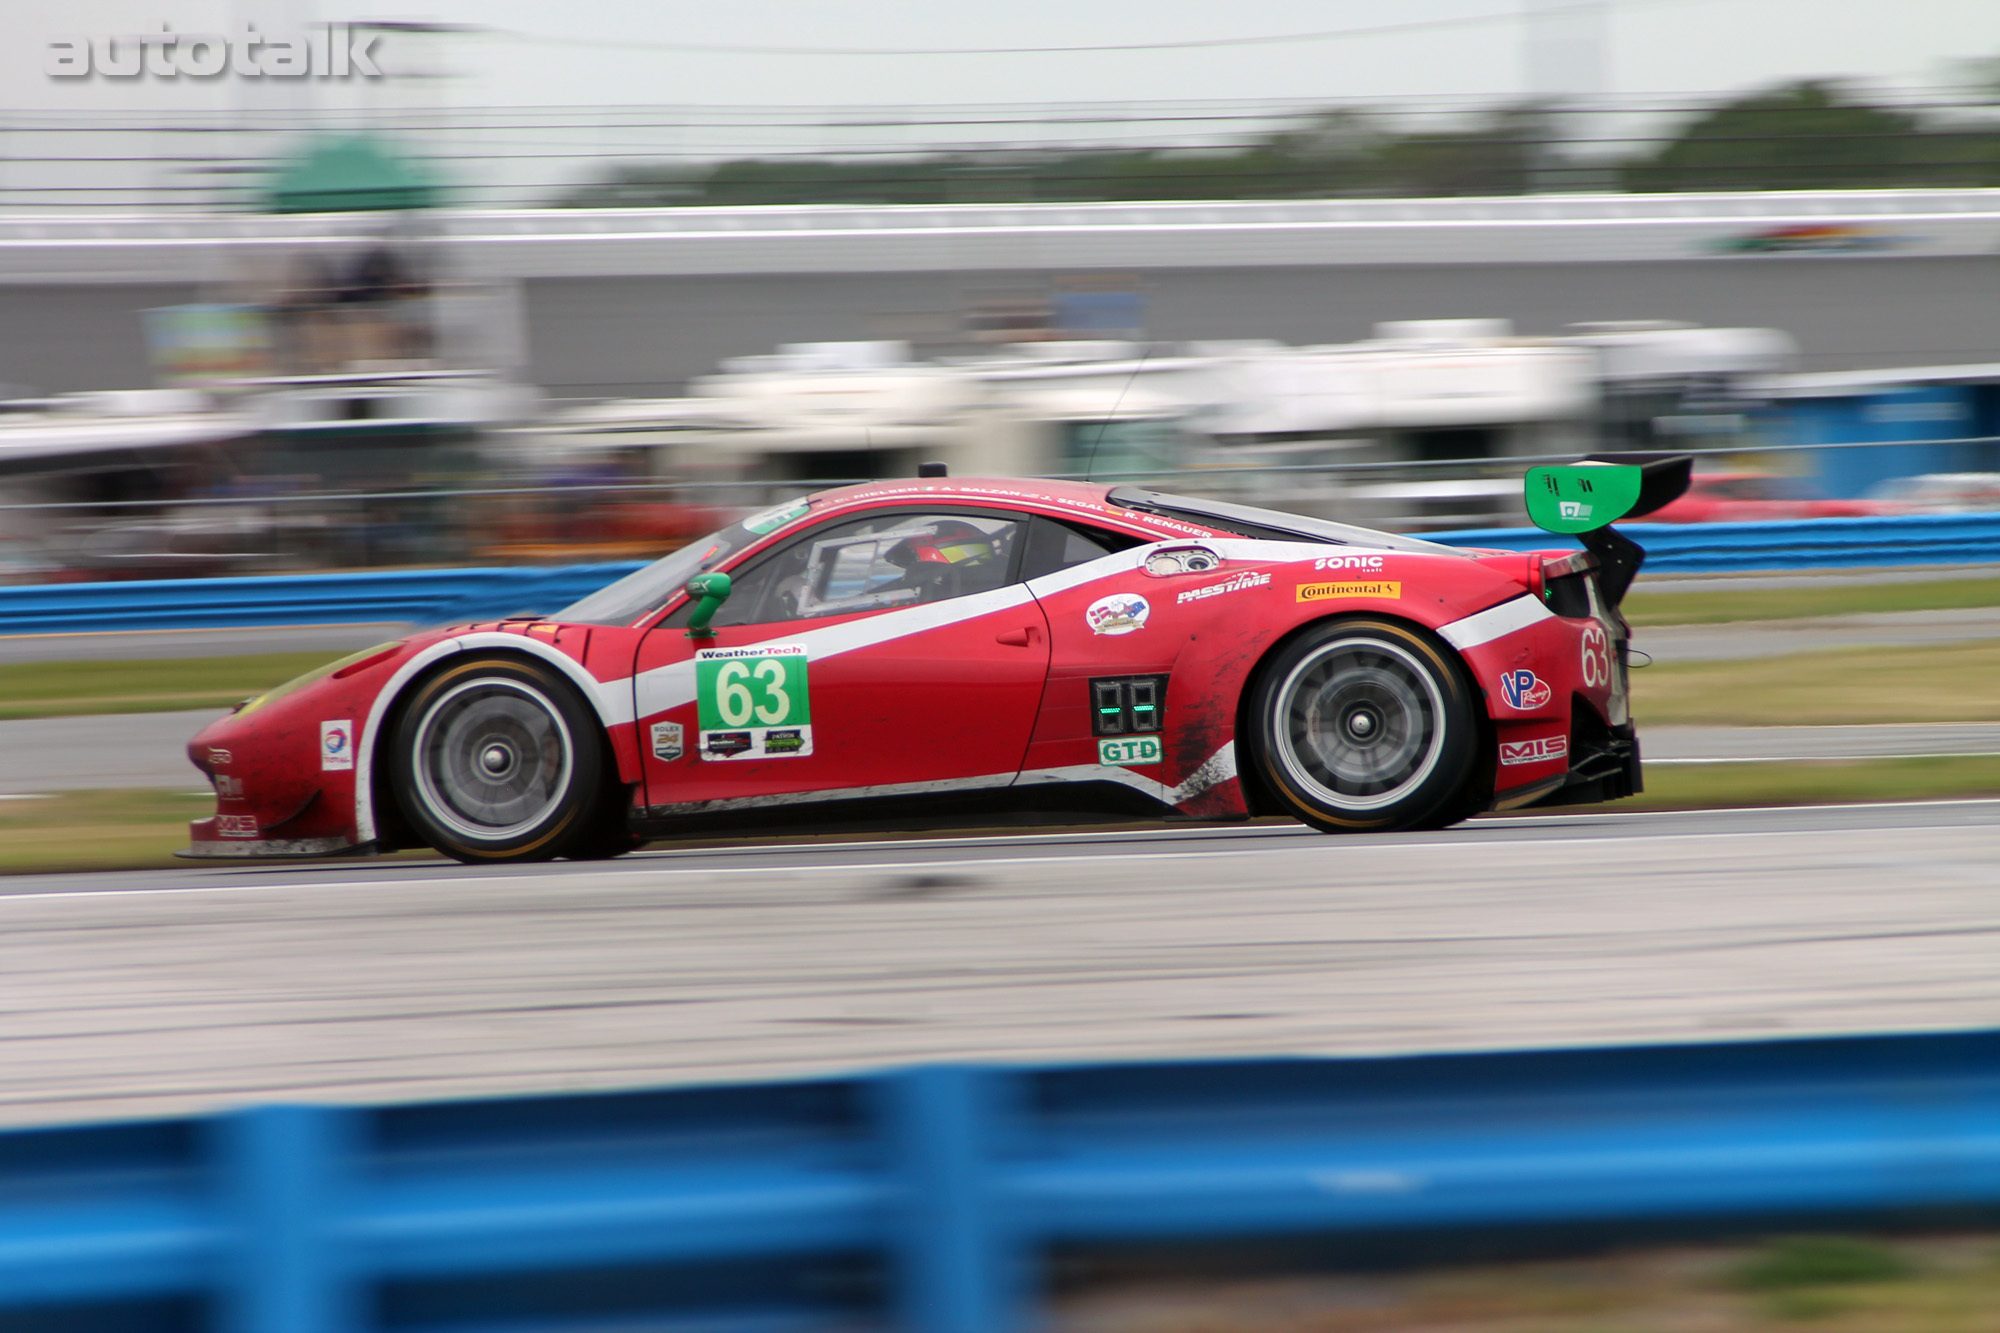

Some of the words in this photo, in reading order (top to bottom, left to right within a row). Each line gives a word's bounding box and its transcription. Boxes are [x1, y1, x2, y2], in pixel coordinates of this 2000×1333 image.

[853, 487, 918, 499] NIELSEN
[960, 487, 1021, 496] BALZAN
[1056, 498, 1105, 512] SEGAL
[1124, 511, 1139, 520] R.
[1142, 516, 1213, 538] RENAUER
[1176, 572, 1272, 604] PASSTIME
[1301, 584, 1381, 599] Continental
[701, 647, 802, 659] WeatherTech
[1581, 627, 1609, 688] 63
[716, 659, 791, 727] 63
[1501, 669, 1536, 709] VP
[1103, 741, 1157, 761] GTD
[1501, 737, 1566, 760] MIS
